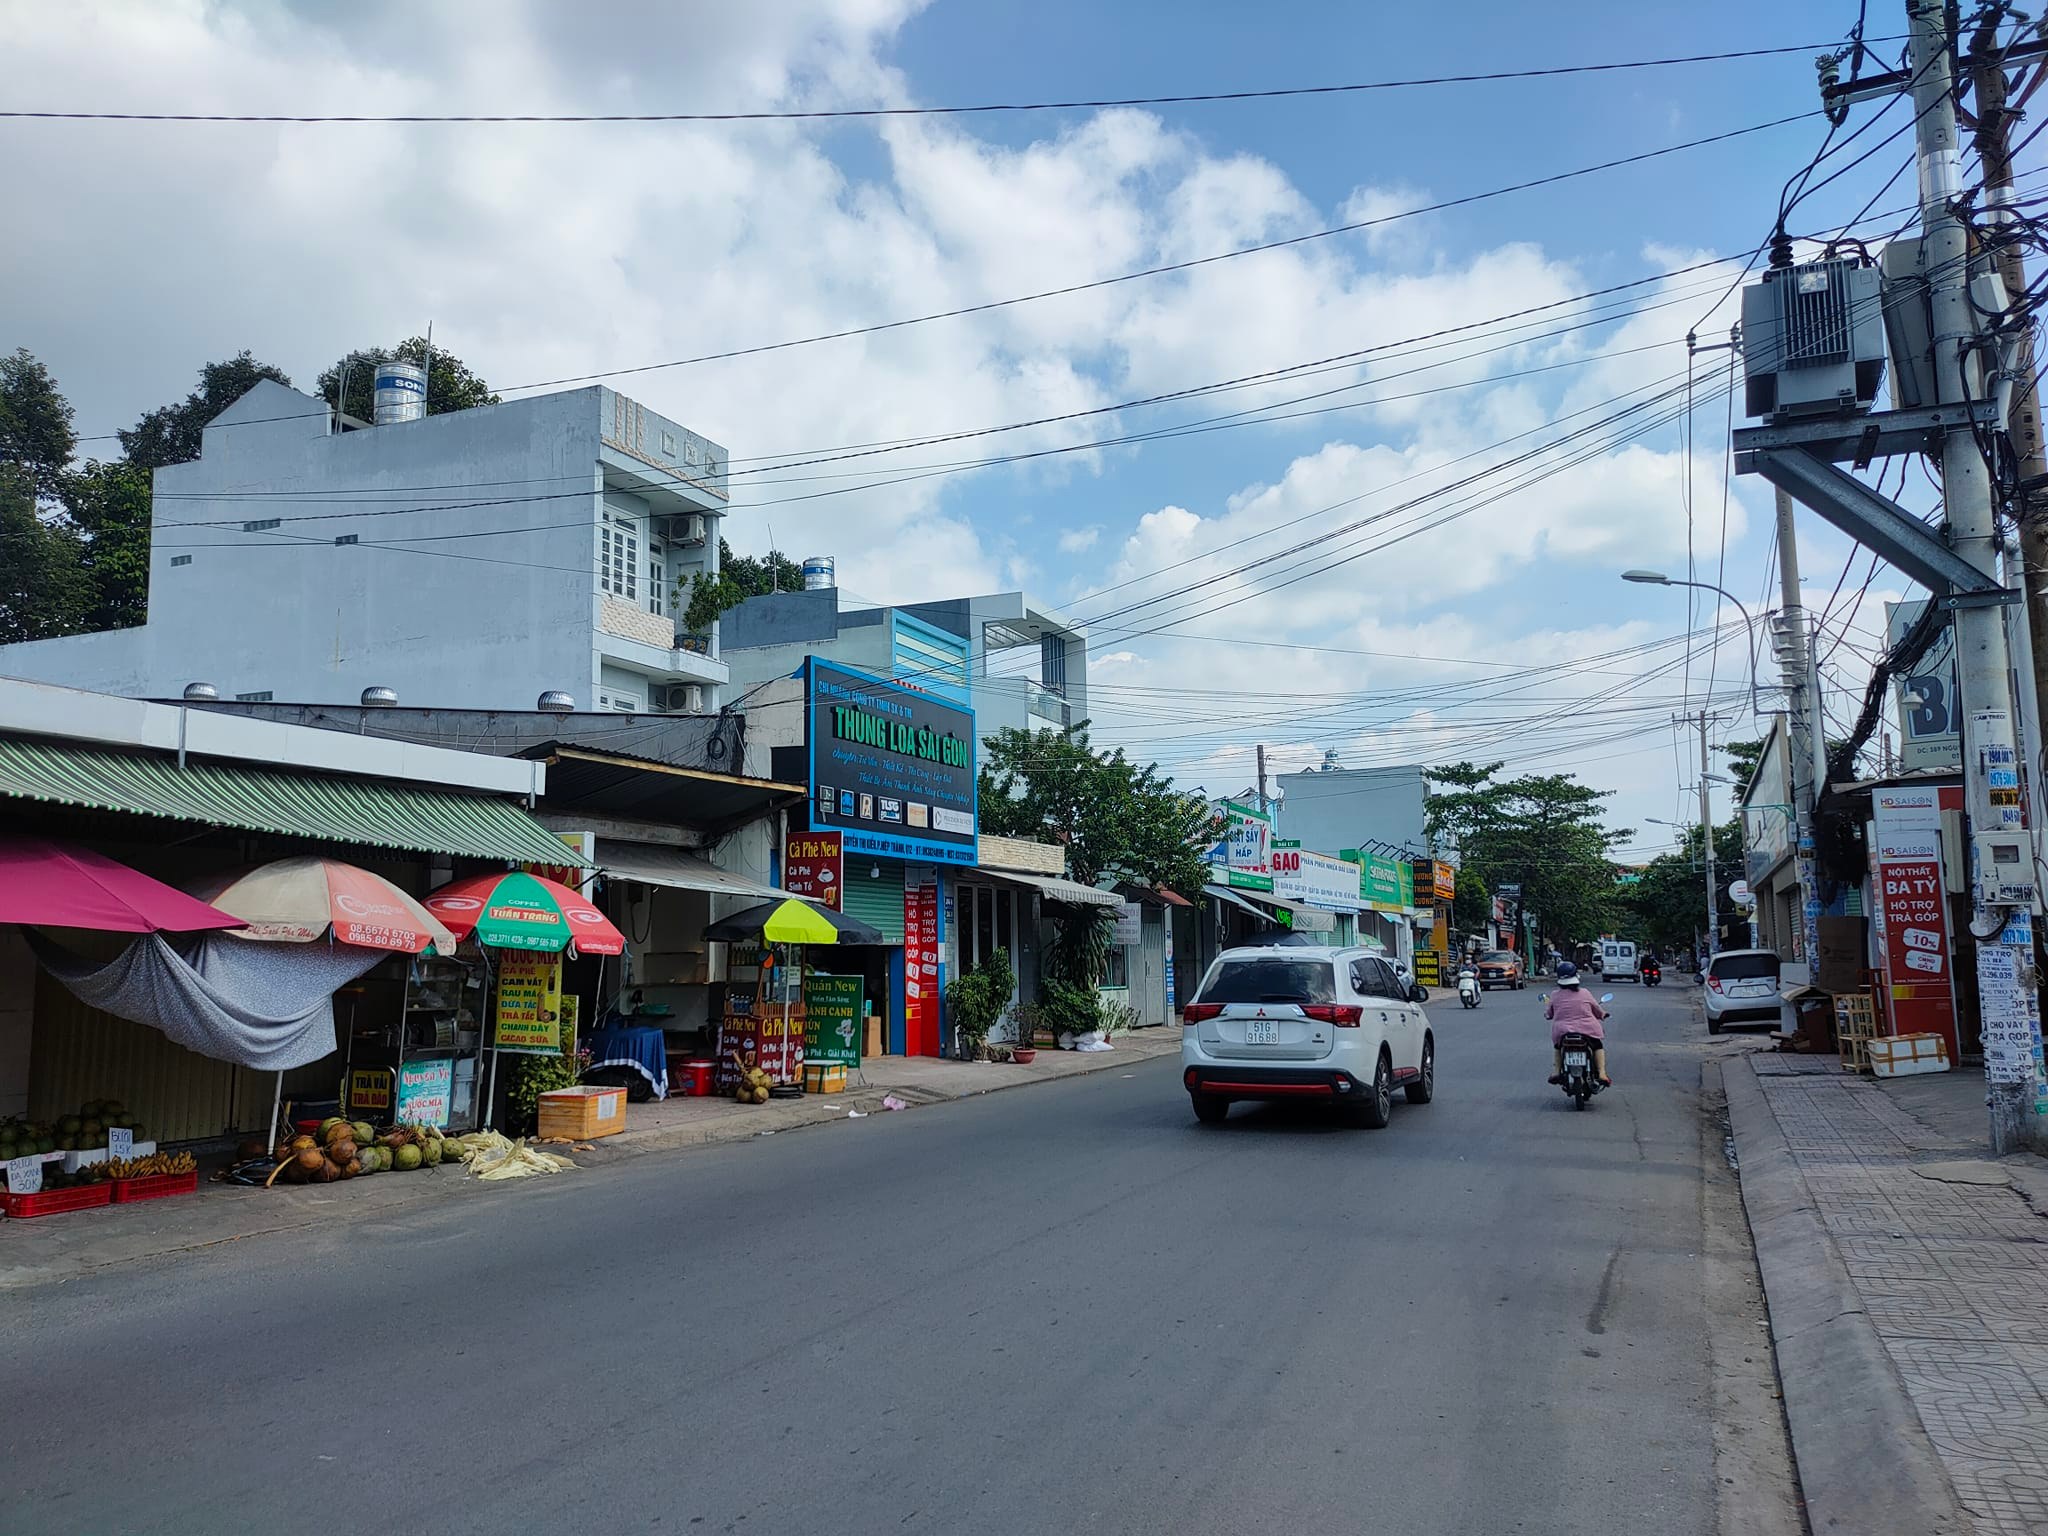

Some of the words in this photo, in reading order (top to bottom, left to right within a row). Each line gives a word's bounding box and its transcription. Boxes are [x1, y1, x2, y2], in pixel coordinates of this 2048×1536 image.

[835, 705, 887, 749] THÙNG
[890, 721, 916, 756] LOA
[918, 724, 940, 762] SÀI
[943, 732, 969, 769] GÒN
[1880, 797, 1894, 806] HD
[1894, 796, 1933, 805] SAISON
[1245, 825, 1259, 843] SẤY
[789, 840, 801, 858] Cà
[802, 841, 819, 858] Phê
[820, 841, 839, 857] New
[1235, 845, 1253, 858] HẤP
[1881, 847, 1895, 855] HD
[1896, 846, 1934, 855] SAISON
[788, 865, 797, 876] Cà
[798, 866, 811, 876] Phê
[1272, 852, 1300, 876] GẠO
[1887, 867, 1905, 878] NỘI
[1905, 865, 1931, 876] THẤT
[788, 881, 803, 891] Sinh
[1885, 880, 1912, 895] BA
[1913, 875, 1937, 894] TỶ
[508, 899, 540, 907] COFFEE
[1910, 899, 1935, 911] TRỢ
[522, 910, 557, 924] TRANG
[1914, 911, 1940, 922] GÓP
[349, 923, 390, 939] 08.6674
[392, 930, 416, 941] 6703
[349, 932, 387, 945] 0985.80
[388, 937, 402, 948] 69
[404, 940, 416, 950] 79
[922, 935, 936, 944] GÓP
[1912, 934, 1937, 949] 10%
[501, 978, 525, 986] CAM
[804, 980, 832, 993] Quán
[835, 980, 857, 992] New
[501, 989, 521, 997] RAU
[829, 1007, 853, 1017] CANH
[501, 1023, 529, 1031] CHANH
[724, 1017, 732, 1031] Cà
[732, 1017, 744, 1031] Phê
[744, 1019, 757, 1032] New
[762, 1017, 773, 1037] Cà
[789, 1017, 804, 1036] New
[1253, 1022, 1271, 1032] 51G
[1989, 1021, 2004, 1029] CHO
[2006, 1020, 2024, 1029] VAY
[501, 1034, 527, 1043] CACAO
[355, 1075, 373, 1089] TRÀ
[353, 1091, 371, 1105] TRÀ
